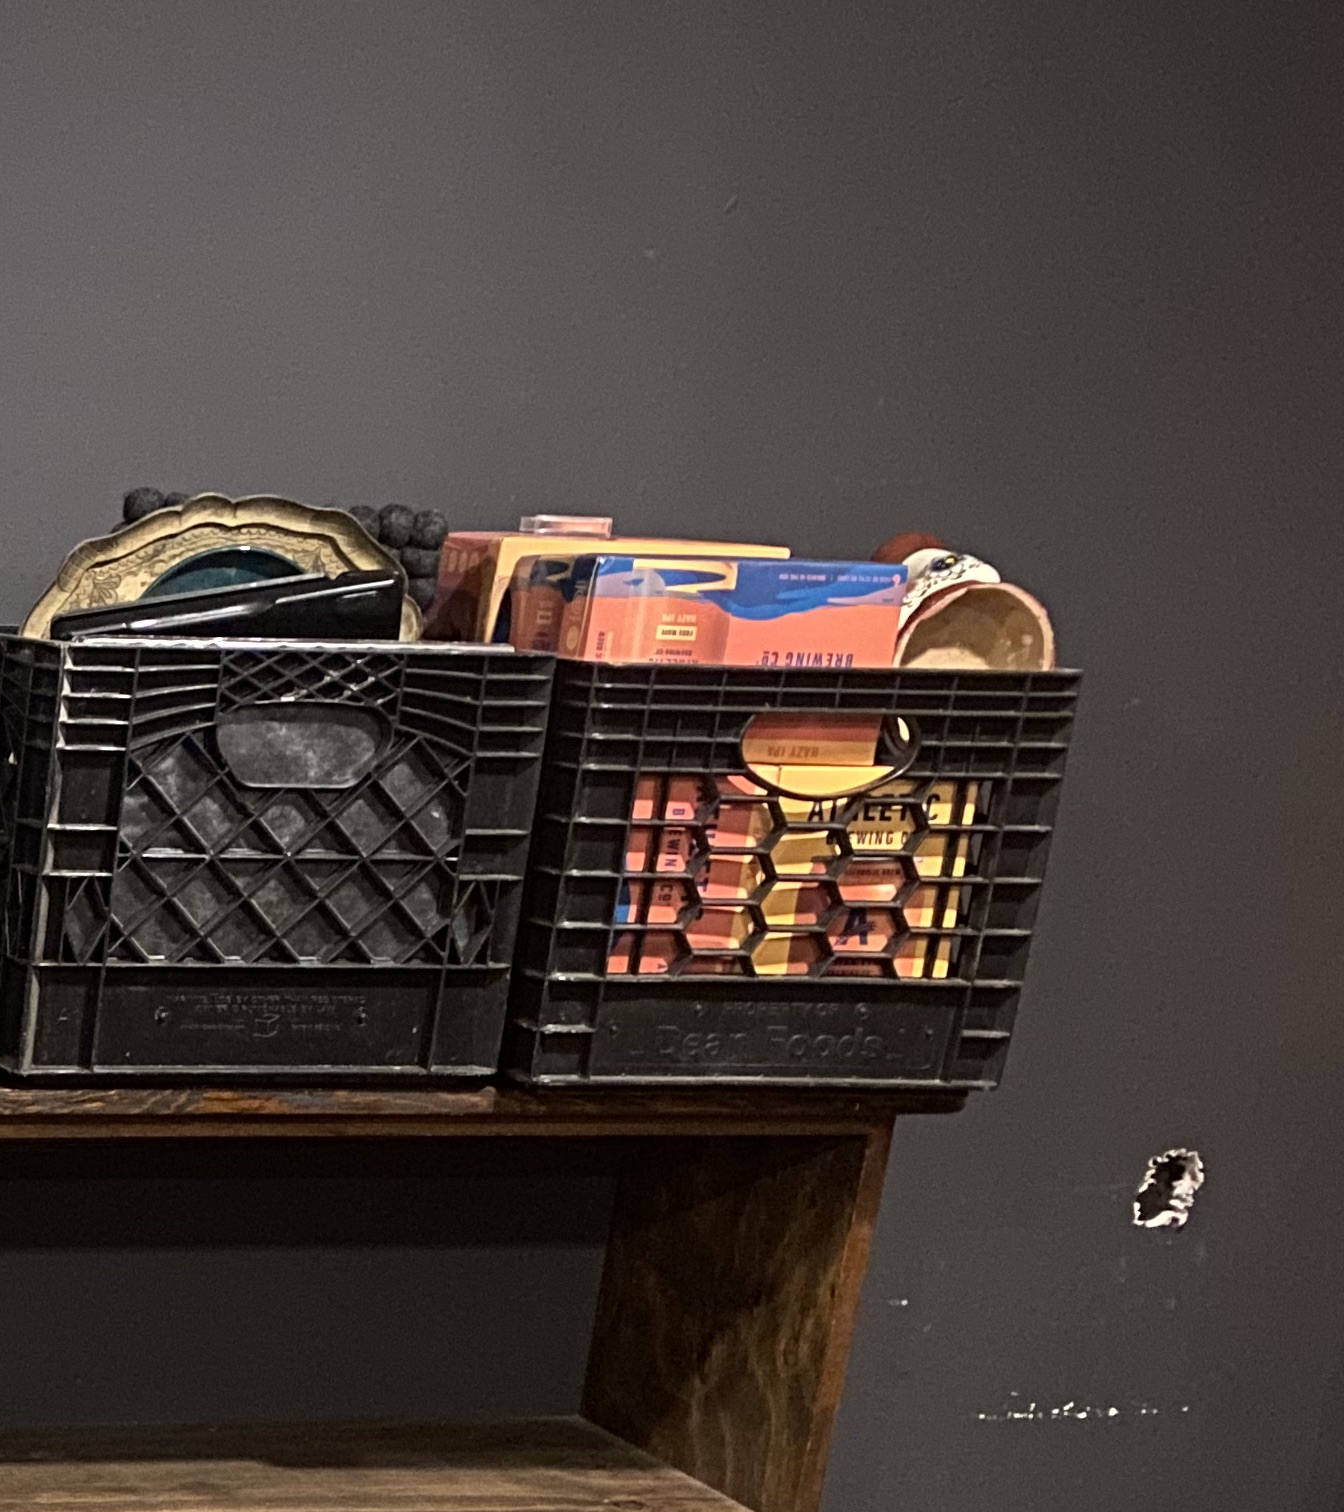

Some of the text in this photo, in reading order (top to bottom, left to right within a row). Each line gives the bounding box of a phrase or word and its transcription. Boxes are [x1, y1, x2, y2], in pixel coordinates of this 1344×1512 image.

[785, 652, 854, 668] BREWING
[767, 745, 819, 758] HAZY IPA
